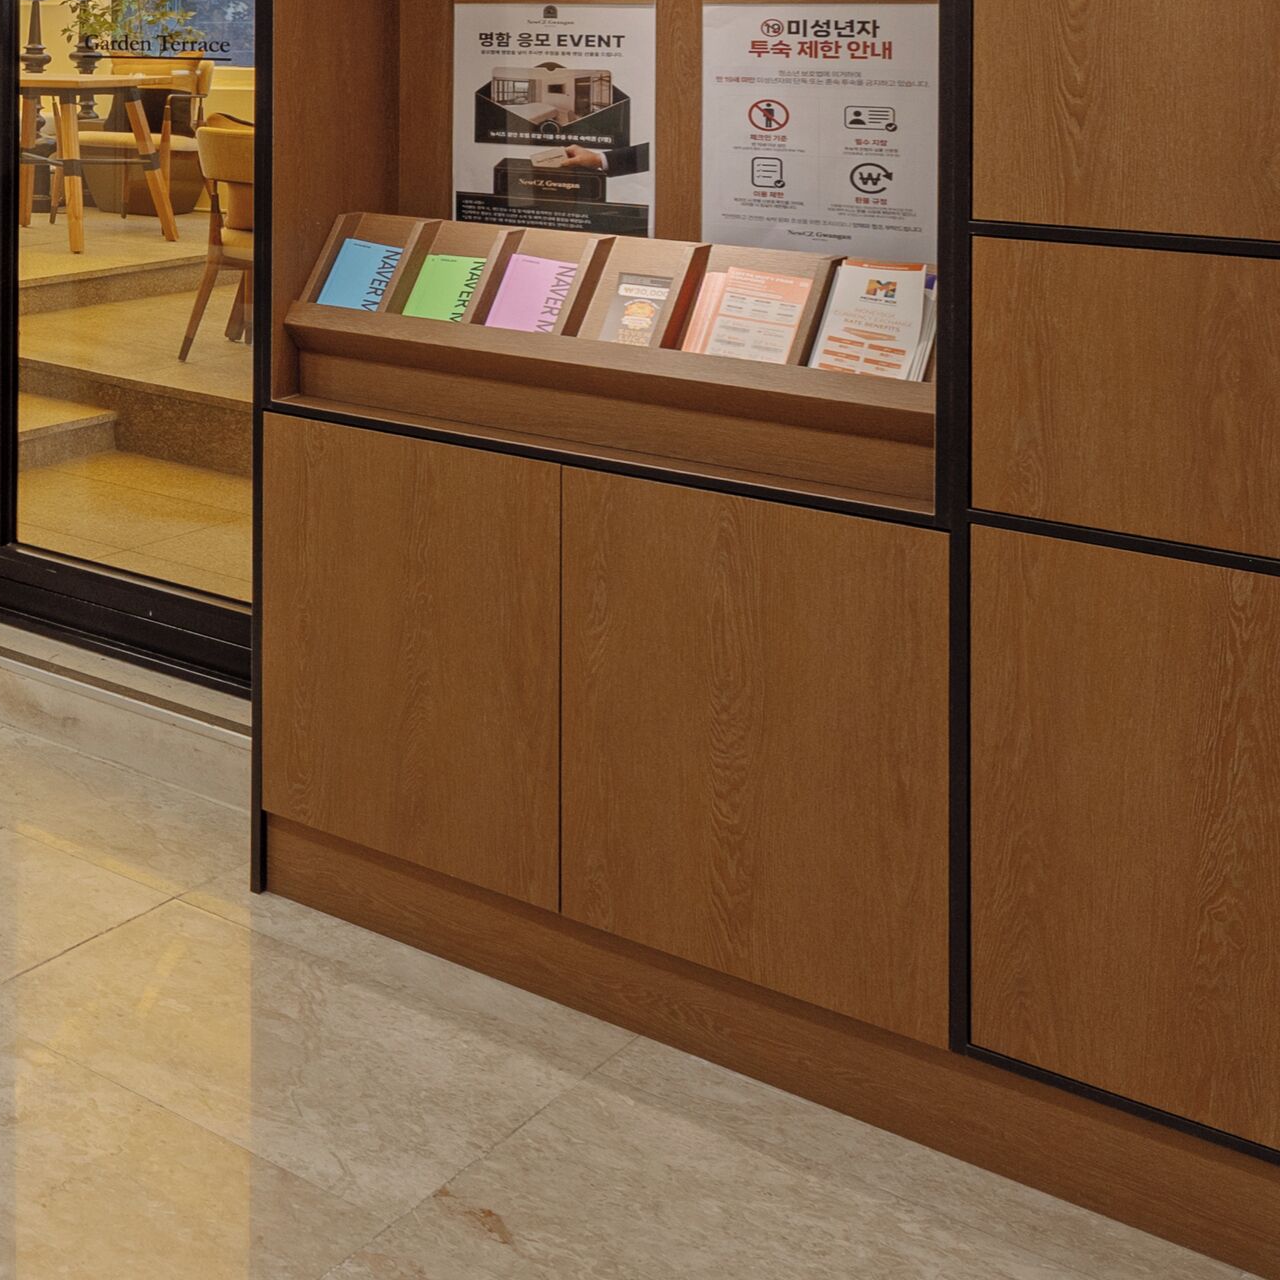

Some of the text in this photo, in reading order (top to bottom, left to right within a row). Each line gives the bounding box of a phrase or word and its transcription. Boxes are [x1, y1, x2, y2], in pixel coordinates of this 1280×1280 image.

[788, 19, 880, 38] 미성년자
[84, 33, 231, 53] Garden Terrace
[478, 31, 625, 48] 명함 응모 EVENT
[748, 40, 893, 60] 투숙 제한 안내
[519, 178, 544, 187] NewCZ
[545, 180, 580, 190] Gwangan
[787, 229, 815, 238] NewCZ
[816, 231, 852, 240] Gwangan
[366, 249, 403, 297] NAVER
[454, 261, 486, 308] NAVER
[540, 265, 577, 316] NAVER
